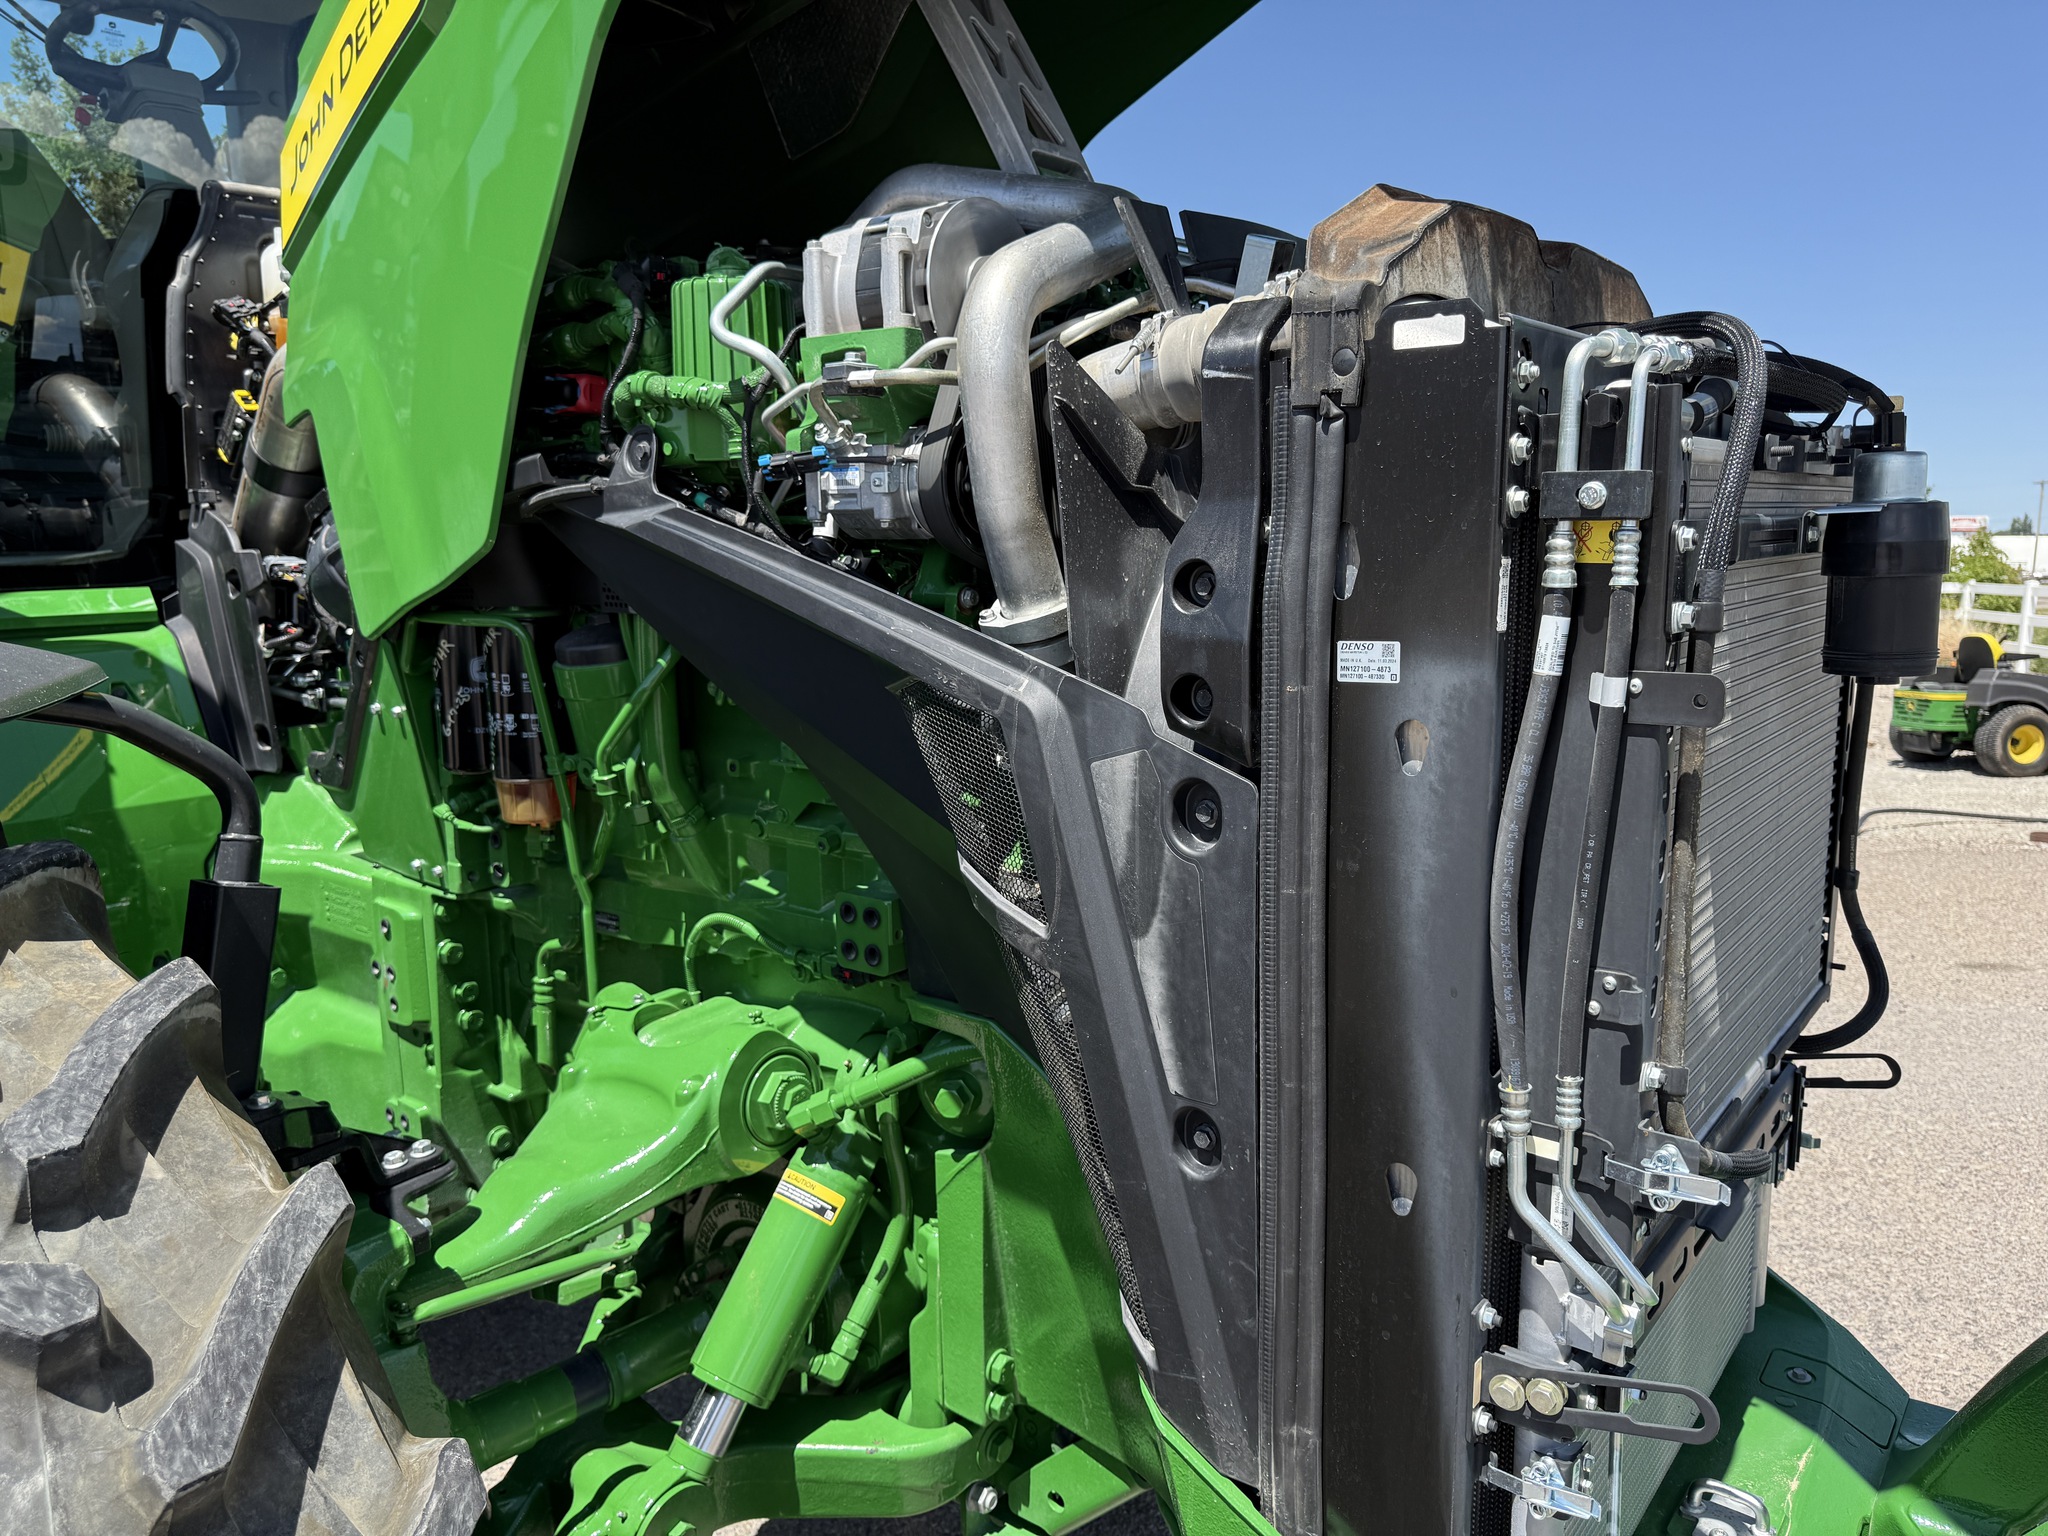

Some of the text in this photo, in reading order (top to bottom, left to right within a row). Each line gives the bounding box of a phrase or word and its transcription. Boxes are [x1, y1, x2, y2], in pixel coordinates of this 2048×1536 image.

[290, 73, 334, 197] JOHN
[1340, 642, 1374, 651] DENSO
[1532, 705, 1546, 721] TYPE
[1522, 753, 1533, 763] 35
[1511, 794, 1525, 811] PSI)
[1505, 840, 1516, 849] to
[1500, 942, 1512, 978] 2024-02-19
[1502, 984, 1514, 1000] Made
[1505, 1012, 1516, 1025] USA
